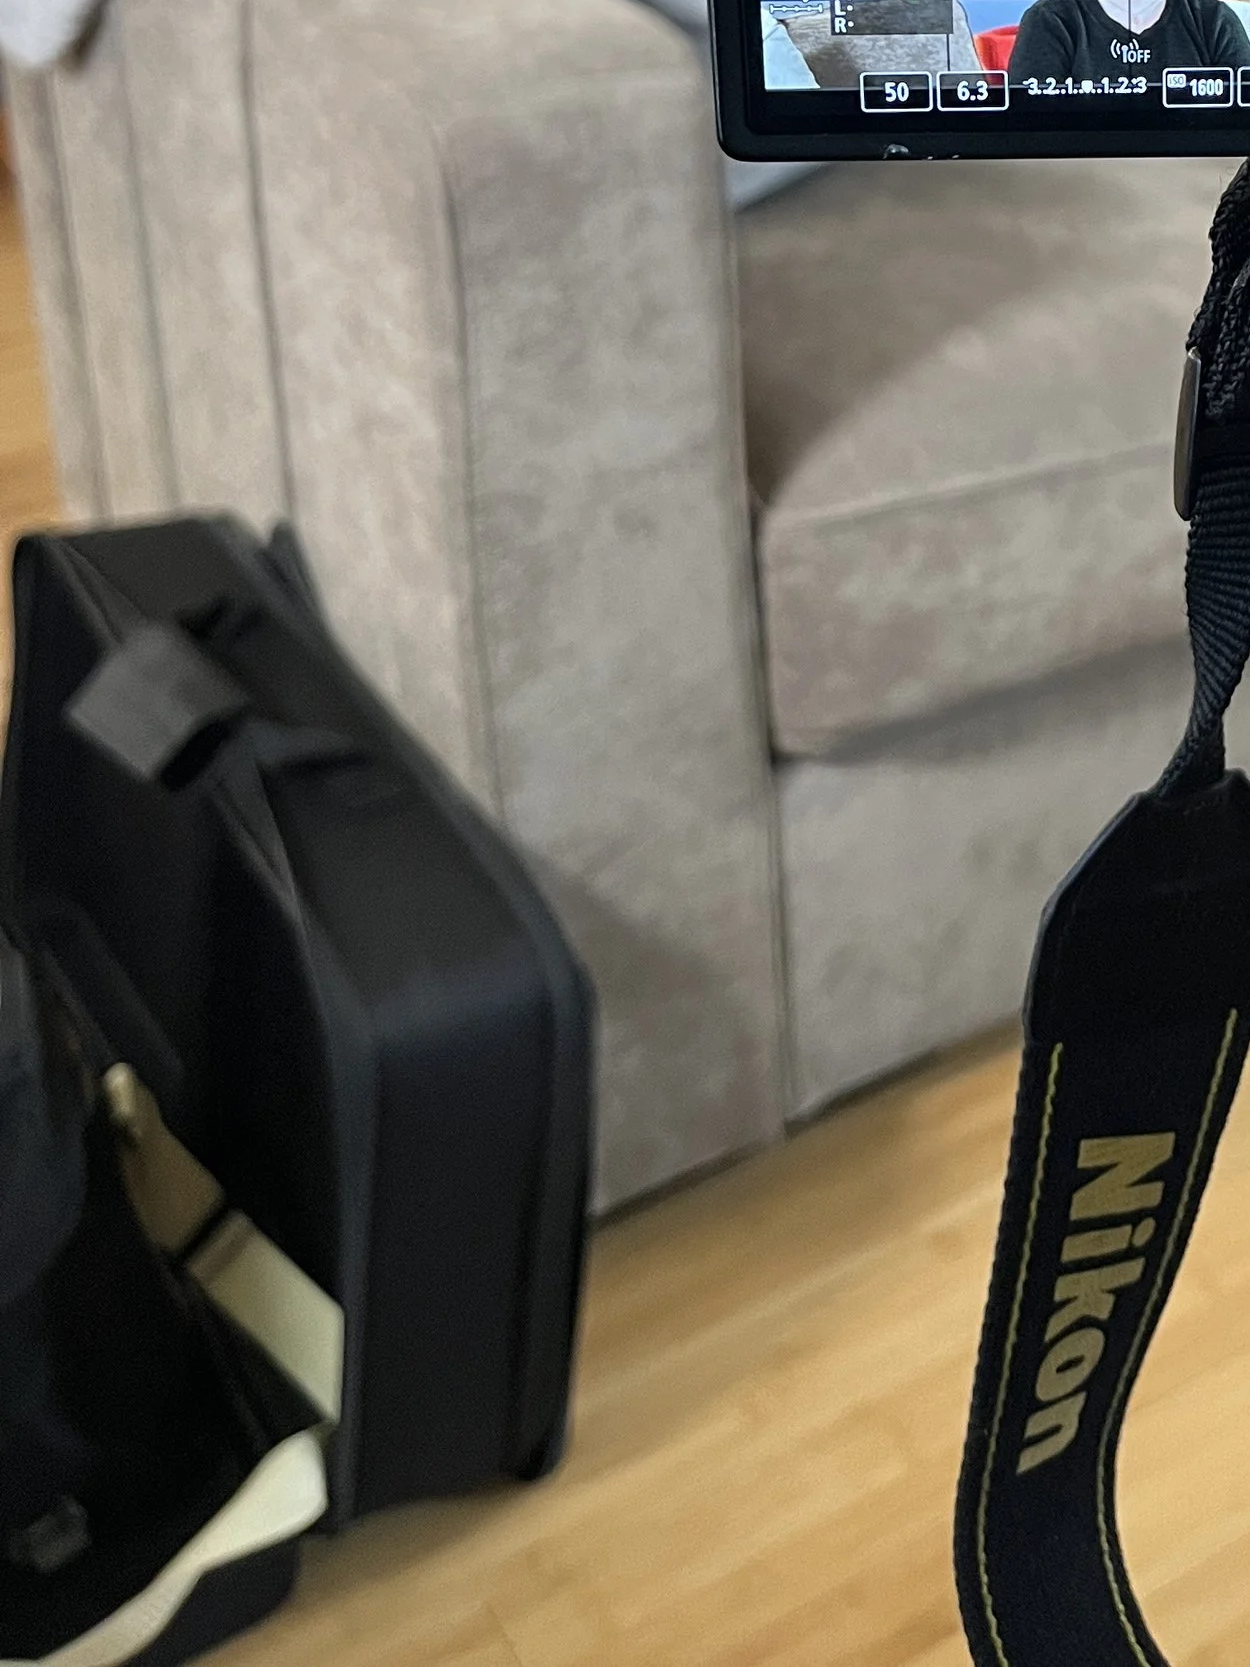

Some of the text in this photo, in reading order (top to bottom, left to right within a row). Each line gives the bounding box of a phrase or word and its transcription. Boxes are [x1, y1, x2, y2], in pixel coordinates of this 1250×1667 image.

[1128, 51, 1151, 63] OFF
[884, 82, 909, 102] 50
[957, 81, 989, 101] 6.3
[1168, 75, 1224, 97] ISO 1600
[1015, 1131, 1176, 1476] Nikon
